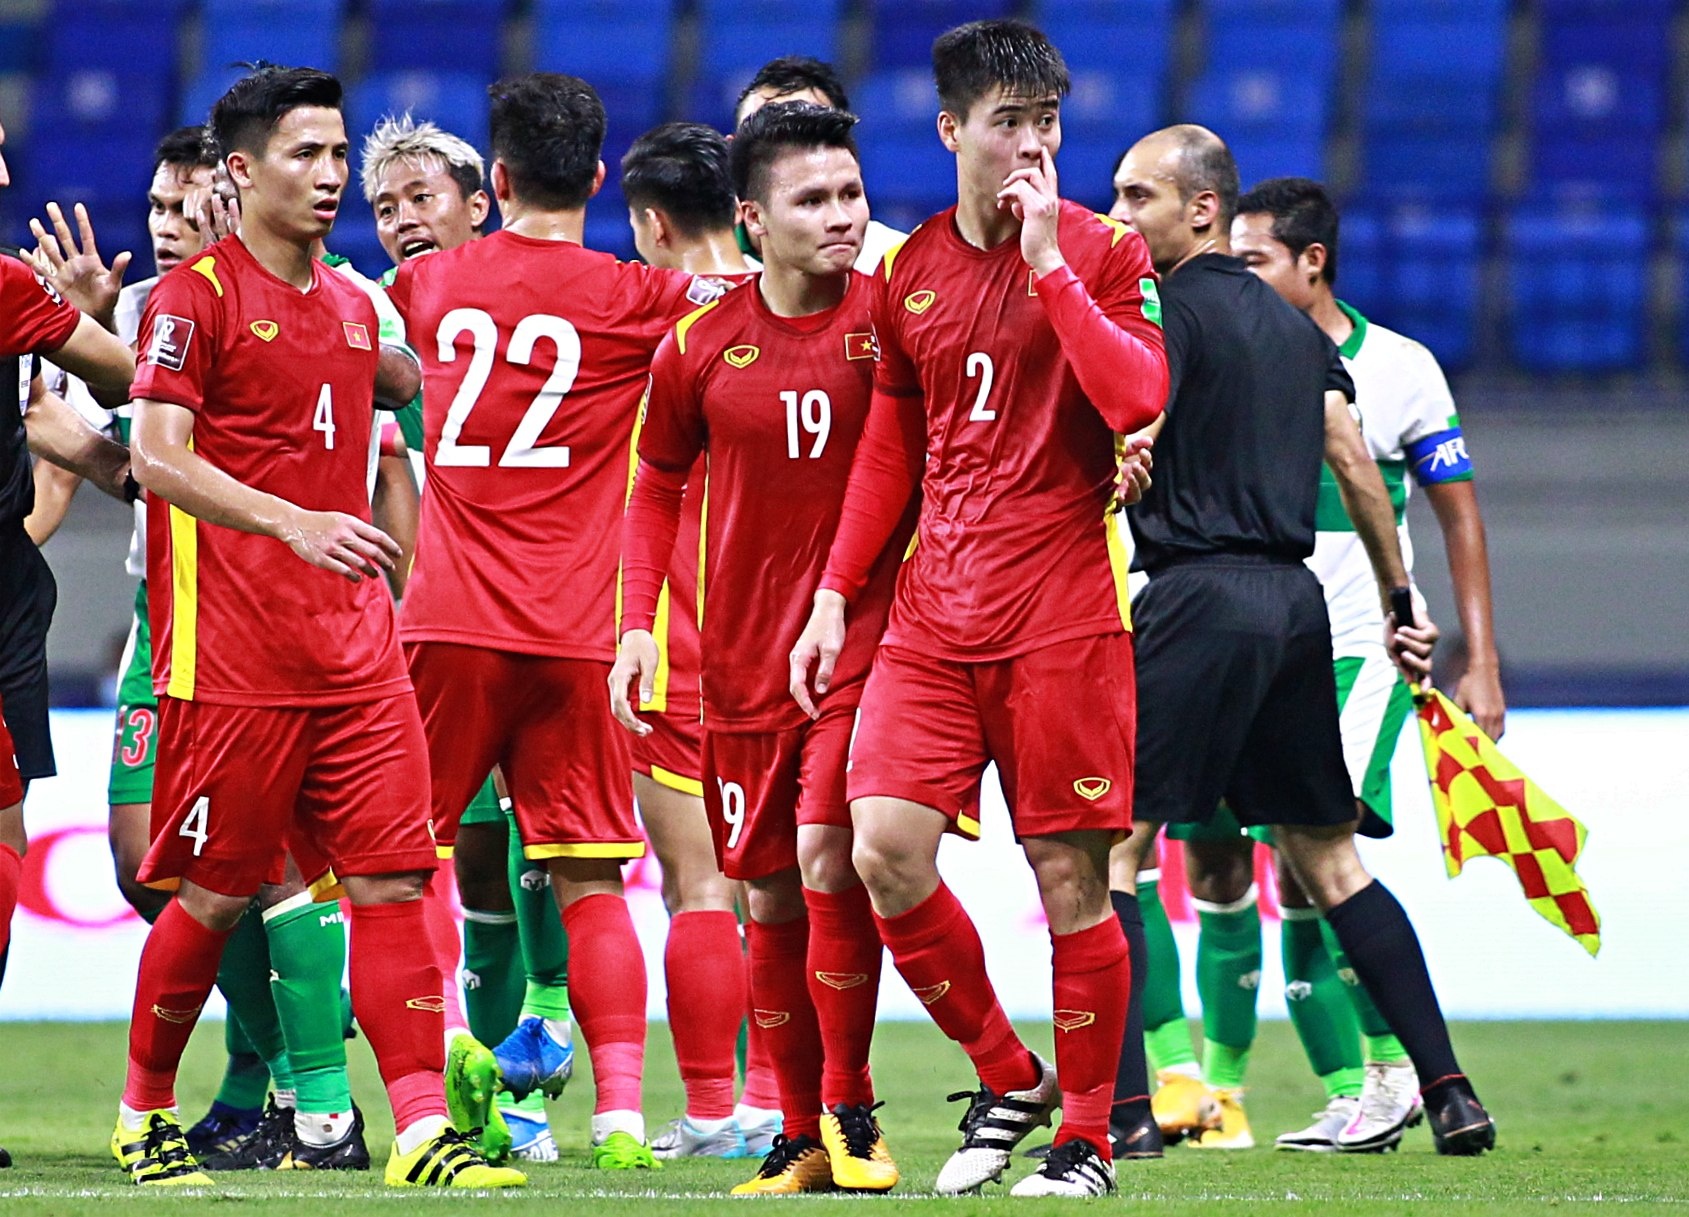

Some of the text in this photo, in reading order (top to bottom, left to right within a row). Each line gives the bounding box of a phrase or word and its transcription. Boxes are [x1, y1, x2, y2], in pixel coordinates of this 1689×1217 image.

[313, 383, 336, 450] 4
[433, 307, 582, 468] 22
[966, 352, 996, 422] 2
[779, 389, 831, 459] 19
[179, 795, 210, 857] 4
